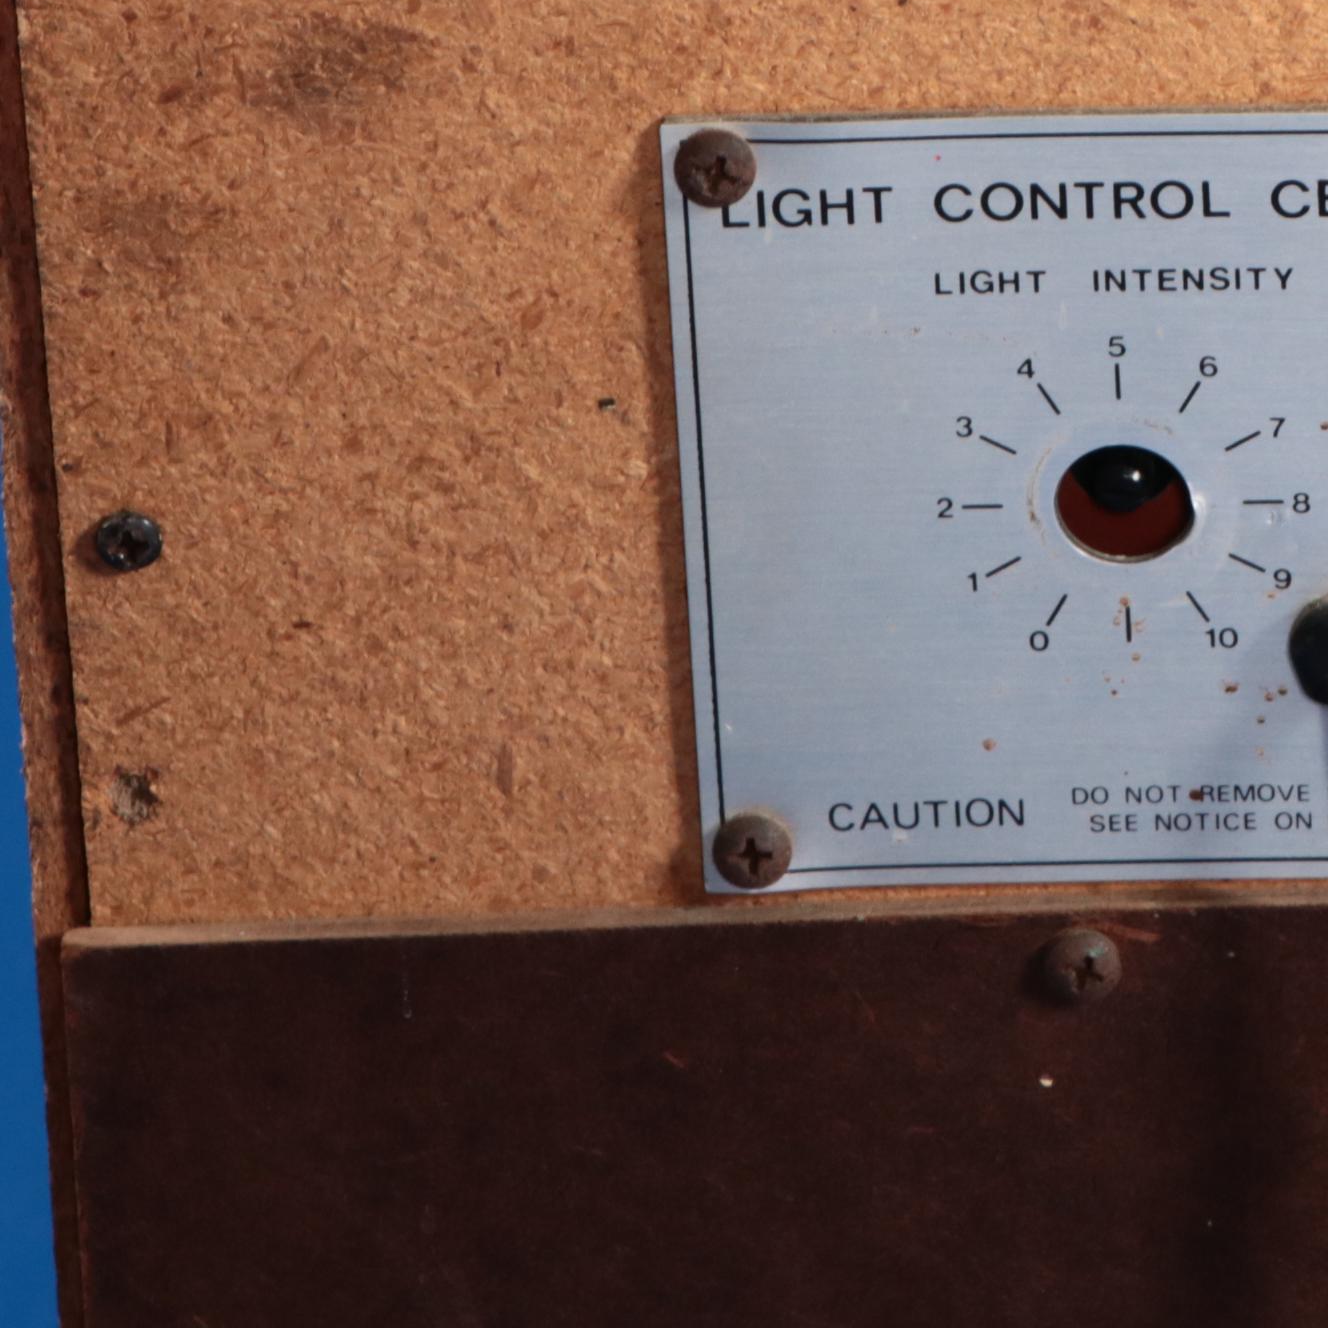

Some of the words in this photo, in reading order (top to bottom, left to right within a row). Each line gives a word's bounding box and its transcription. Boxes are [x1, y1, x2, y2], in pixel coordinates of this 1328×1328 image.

[721, 186, 893, 228] LIGHT
[933, 180, 1231, 222] CONTROL
[934, 270, 1047, 295] LIGHT
[1092, 267, 1294, 292] INTENSITY
[1107, 336, 1127, 358] 5
[1016, 358, 1036, 379] 4
[1199, 356, 1219, 378] 6
[955, 416, 974, 438] 3
[1269, 418, 1286, 438] 7
[936, 498, 954, 519] 2
[1292, 493, 1311, 514] 8
[968, 573, 978, 592] 1
[1273, 569, 1293, 590] 9
[1029, 631, 1050, 652] 0
[1205, 628, 1239, 650] 10
[1072, 786, 1109, 805] DO
[1126, 785, 1181, 804] NOT
[1198, 783, 1310, 803] REMOVE
[828, 798, 1025, 831] CAUTION
[1089, 814, 1138, 833] SEE
[1155, 813, 1257, 832] NOTICE
[1275, 811, 1313, 830] ON
